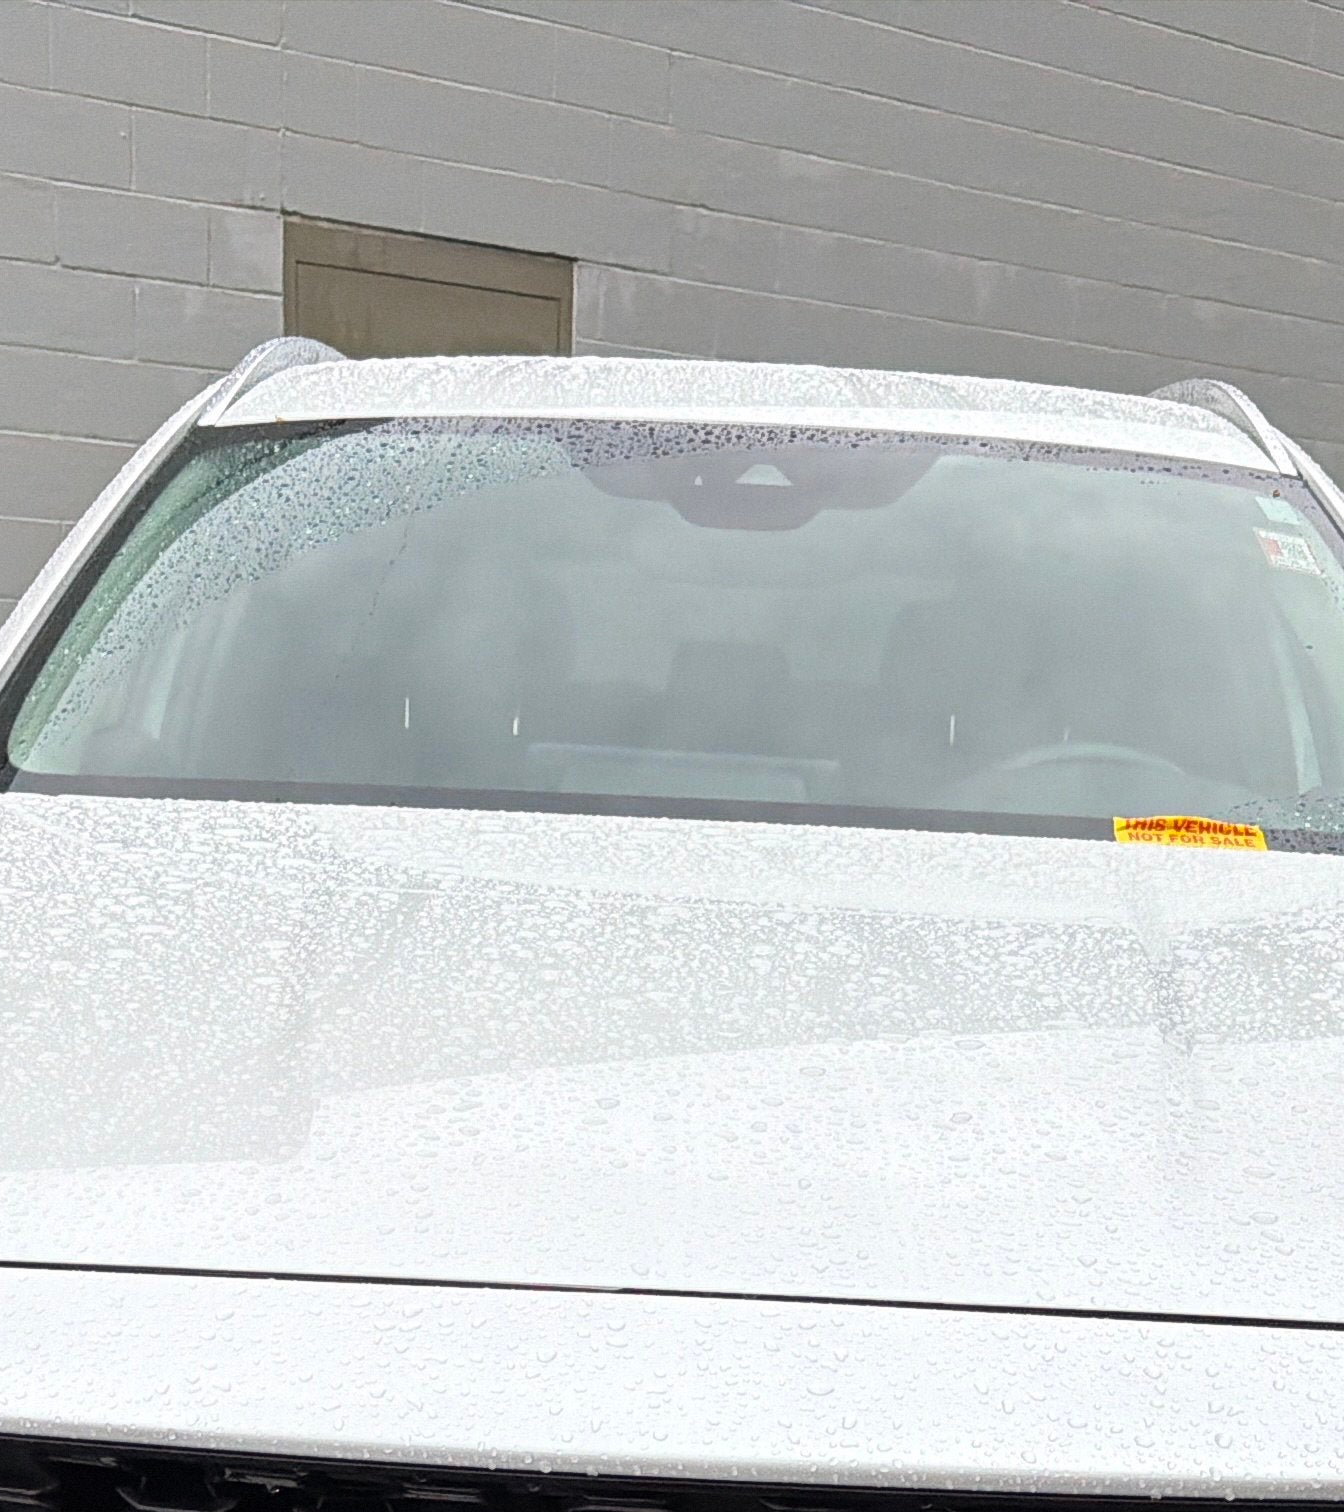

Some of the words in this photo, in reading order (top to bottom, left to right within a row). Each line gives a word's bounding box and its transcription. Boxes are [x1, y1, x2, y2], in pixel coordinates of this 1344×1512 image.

[1125, 818, 1167, 832] THIS
[1173, 818, 1257, 837] VEHICLE
[1128, 832, 1163, 842] NOT
[1169, 834, 1204, 845] FOR
[1210, 836, 1256, 848] SALE
